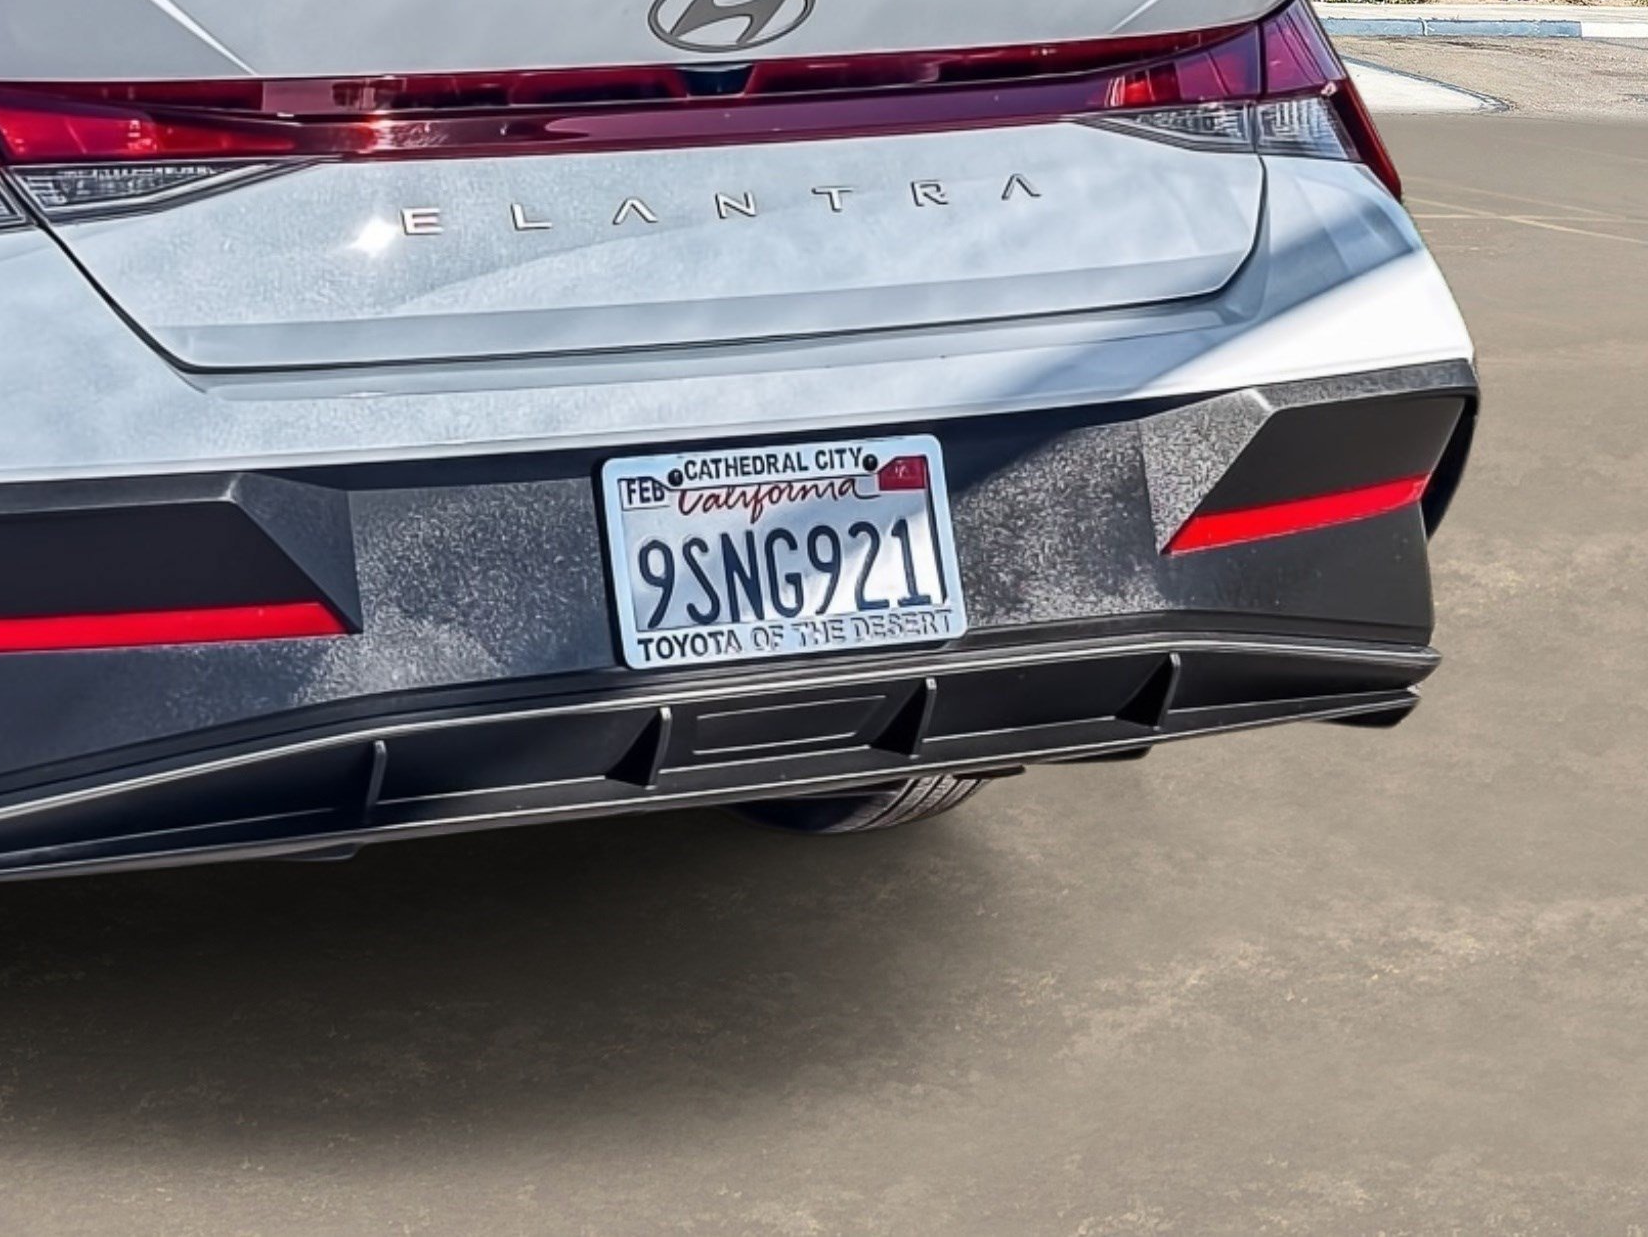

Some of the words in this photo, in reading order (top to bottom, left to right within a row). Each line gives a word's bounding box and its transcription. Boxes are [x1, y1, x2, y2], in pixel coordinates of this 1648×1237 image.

[401, 173, 1041, 236] ELANTRA
[684, 450, 809, 481] CATHEDRAL
[815, 447, 863, 470] CITY
[625, 478, 664, 505] FEB
[678, 476, 882, 523] California
[638, 519, 932, 628] 9SNG921
[638, 630, 742, 661] TOYOTA
[752, 625, 784, 650] OF
[793, 617, 846, 646] THE
[851, 609, 953, 640] DESERT
